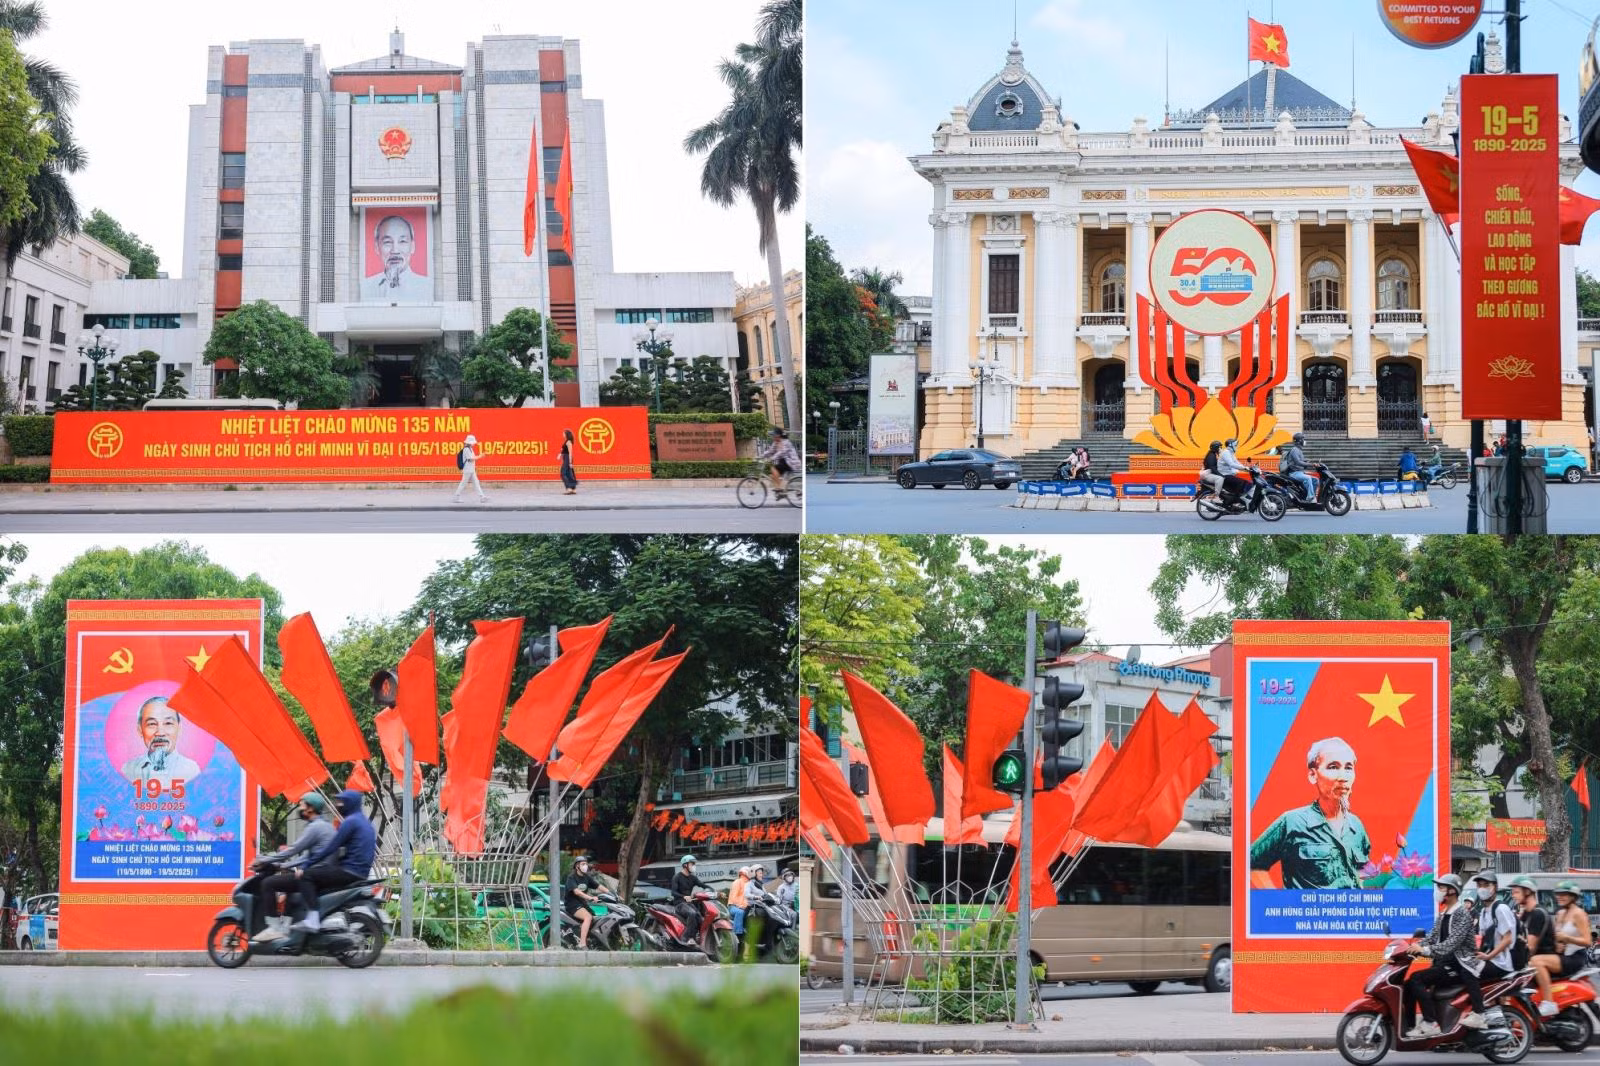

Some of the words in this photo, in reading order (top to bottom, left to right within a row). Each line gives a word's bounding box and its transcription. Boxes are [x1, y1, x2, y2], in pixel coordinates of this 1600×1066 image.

[1388, 4, 1438, 13] COMMITTED
[1440, 5, 1450, 13] TO
[1452, 5, 1475, 14] YOUR
[1404, 16, 1423, 24] BEST
[1424, 16, 1460, 24] RETURNS
[1480, 106, 1538, 136] 19-5
[1473, 139, 1547, 152] 1890-2025
[1496, 184, 1523, 202] SỐNG,
[1484, 207, 1511, 224] CHIẾN
[1488, 233, 1505, 248] LAO
[1507, 230, 1532, 251] ĐỘNG
[1484, 253, 1496, 271] VÀ
[1498, 256, 1517, 274] HỌC
[1519, 253, 1536, 274] TẬP
[1180, 279, 1196, 287] 30.4
[1482, 280, 1505, 294] THEO
[1507, 279, 1538, 294] GƯƠNG
[1476, 300, 1495, 318] BÁC
[1497, 300, 1510, 318] HỒ
[1512, 300, 1522, 318] VĨ
[1523, 304, 1538, 320] ĐẠI
[221, 416, 264, 438] NHIỆT
[270, 416, 300, 438] LIỆT
[305, 416, 346, 434] CHÀO
[352, 414, 397, 433] MỪNG
[402, 417, 430, 433] 135
[434, 413, 471, 433] NĂM
[144, 442, 177, 458] NGÀY
[181, 443, 210, 457] SINH
[214, 438, 240, 457] CHỦ
[244, 443, 271, 460] TỊCH
[275, 440, 292, 457] HỒ
[295, 440, 316, 456] CHÍ
[320, 442, 354, 456] MINH
[358, 440, 370, 456] VĨ
[373, 442, 394, 460] ĐẠI
[1260, 678, 1295, 695] 19-5
[132, 778, 185, 799] 19-5
[104, 844, 124, 853] NHIỆT
[126, 844, 140, 853] LIỆT
[141, 844, 158, 852] CHÀO
[160, 844, 180, 852] MỪNG
[196, 844, 212, 852] NĂM
[92, 856, 109, 864] NGÀY
[112, 856, 127, 864] SINH
[130, 855, 142, 864] CHỦ
[144, 856, 159, 866] TỊCH
[161, 855, 170, 864] HỒ
[172, 855, 183, 863] CHÍ
[204, 855, 211, 863] VĨ
[212, 856, 224, 866] ĐẠI
[117, 868, 152, 876] (19/5/1890
[159, 868, 193, 876] 19/5/2025)
[1301, 892, 1317, 903] CHỦ
[1318, 894, 1335, 905] TỊCH
[1337, 892, 1347, 902] HỒ
[1349, 892, 1361, 902] CHÍ
[1363, 894, 1383, 903] MINH
[1265, 908, 1281, 916] ANH
[1283, 906, 1303, 916] HÙNG
[1305, 906, 1320, 916] GIẢI
[1322, 906, 1347, 916] PHÓNG
[1349, 906, 1364, 916] DÂN
[1366, 906, 1380, 918] TỘC
[1382, 906, 1398, 918] VIỆT
[1400, 907, 1420, 917] NAM,
[1296, 920, 1311, 930] NHÀ
[1314, 920, 1328, 930] VĂN
[1330, 920, 1345, 930] HÓA
[1347, 920, 1362, 932] KIỆT
